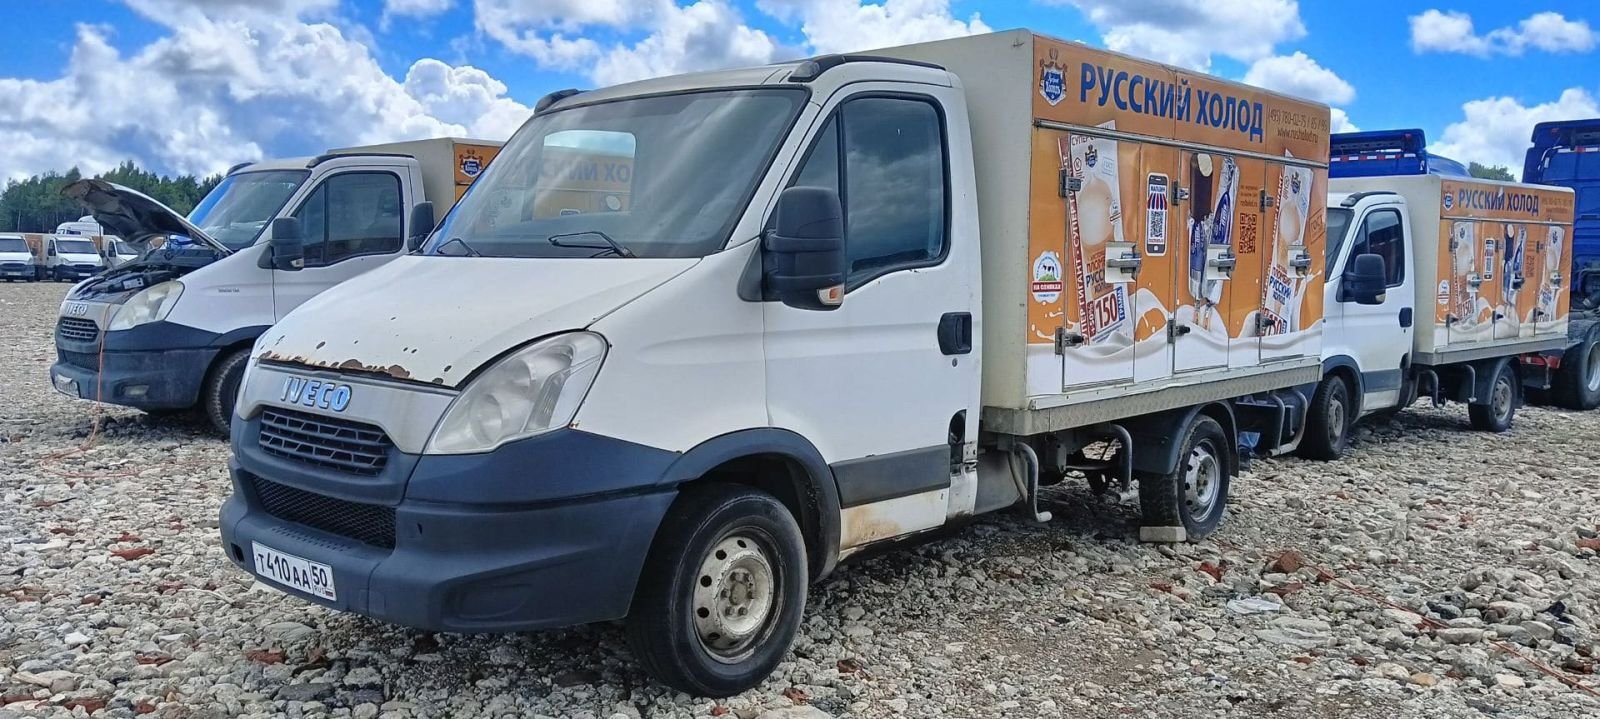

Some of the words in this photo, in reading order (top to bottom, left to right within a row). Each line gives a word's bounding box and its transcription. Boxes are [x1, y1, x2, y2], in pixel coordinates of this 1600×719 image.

[1080, 62, 1192, 122] РУССКИЙ
[1196, 89, 1264, 143] ХОЛОД
[1507, 192, 1539, 216] ХОЛОД
[1095, 293, 1118, 328] 150
[280, 375, 353, 412] IVECO
